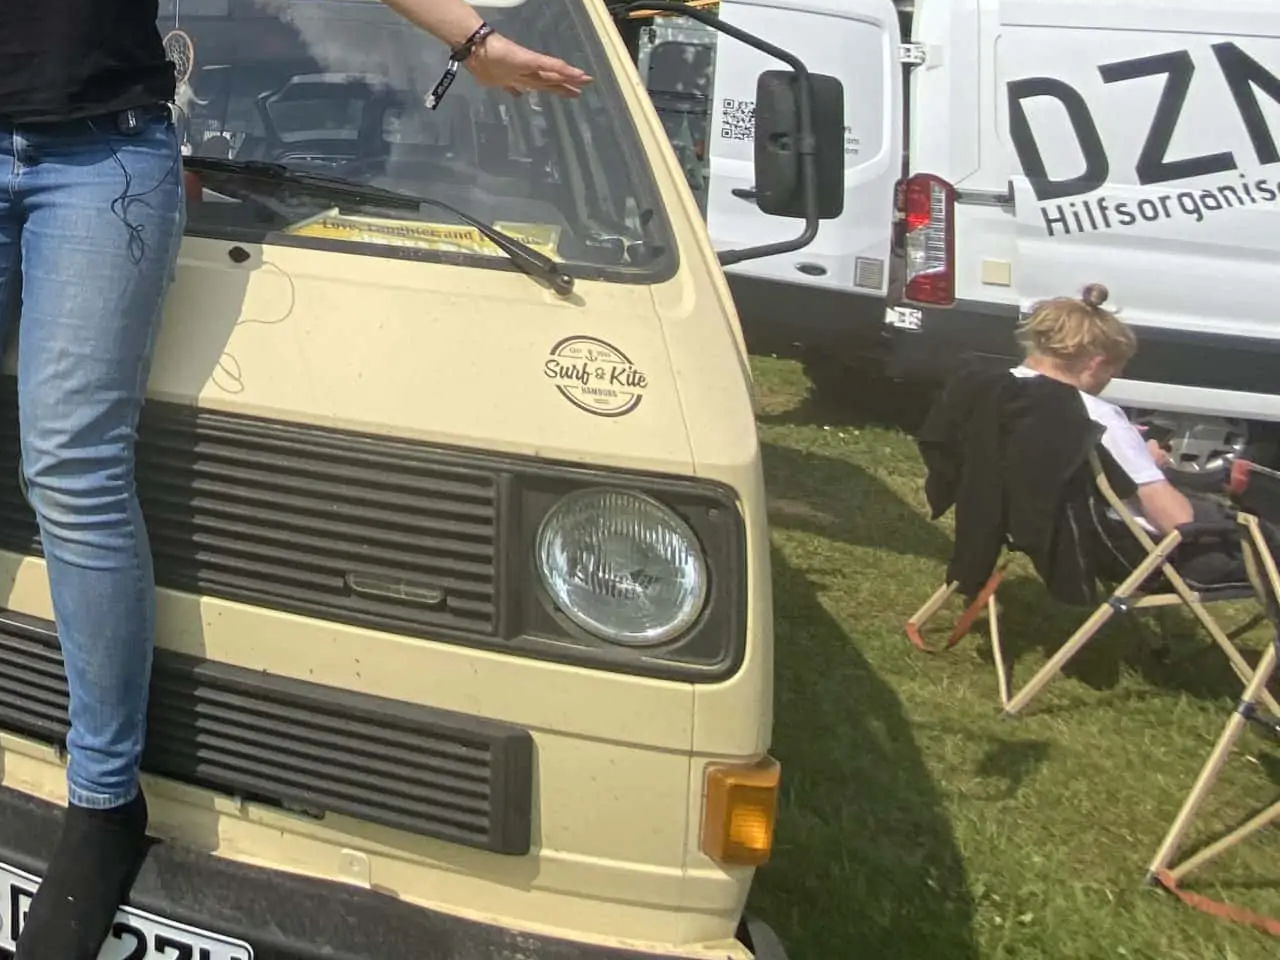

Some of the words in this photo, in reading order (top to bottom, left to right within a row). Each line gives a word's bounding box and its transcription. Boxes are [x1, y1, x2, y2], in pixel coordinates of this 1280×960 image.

[544, 359, 592, 386] Surf
[594, 367, 606, 380] &
[609, 365, 648, 389] Kite
